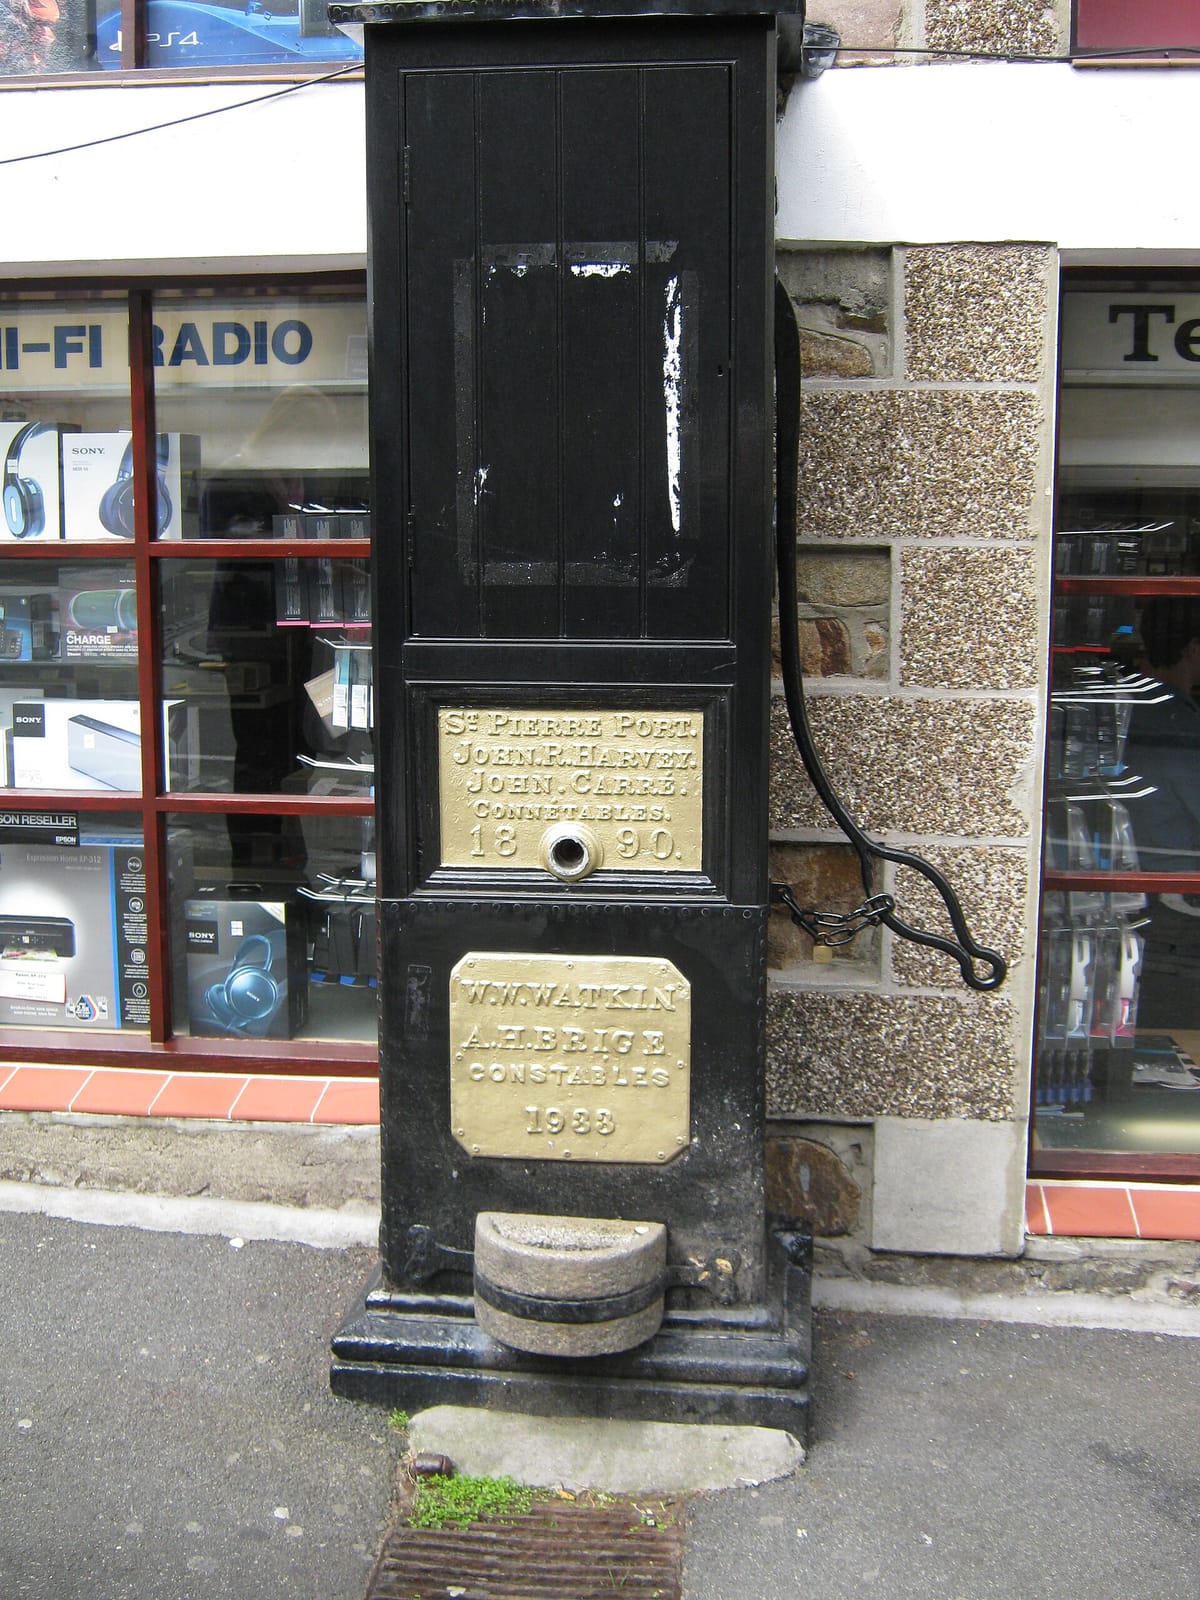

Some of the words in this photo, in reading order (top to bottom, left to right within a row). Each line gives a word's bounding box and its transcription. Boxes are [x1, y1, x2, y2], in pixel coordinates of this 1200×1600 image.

[0, 325, 102, 370] I-FI
[66, 634, 112, 645] CHARGE
[16, 716, 42, 724] SONY
[487, 711, 602, 737] PIERRE
[612, 713, 698, 738] PORT.
[21, 815, 77, 826] RESELLER
[55, 835, 77, 843] EPSON
[188, 931, 215, 940] SONY
[469, 1062, 671, 1088] CONSTABLES
[525, 1105, 617, 1136] 1933
